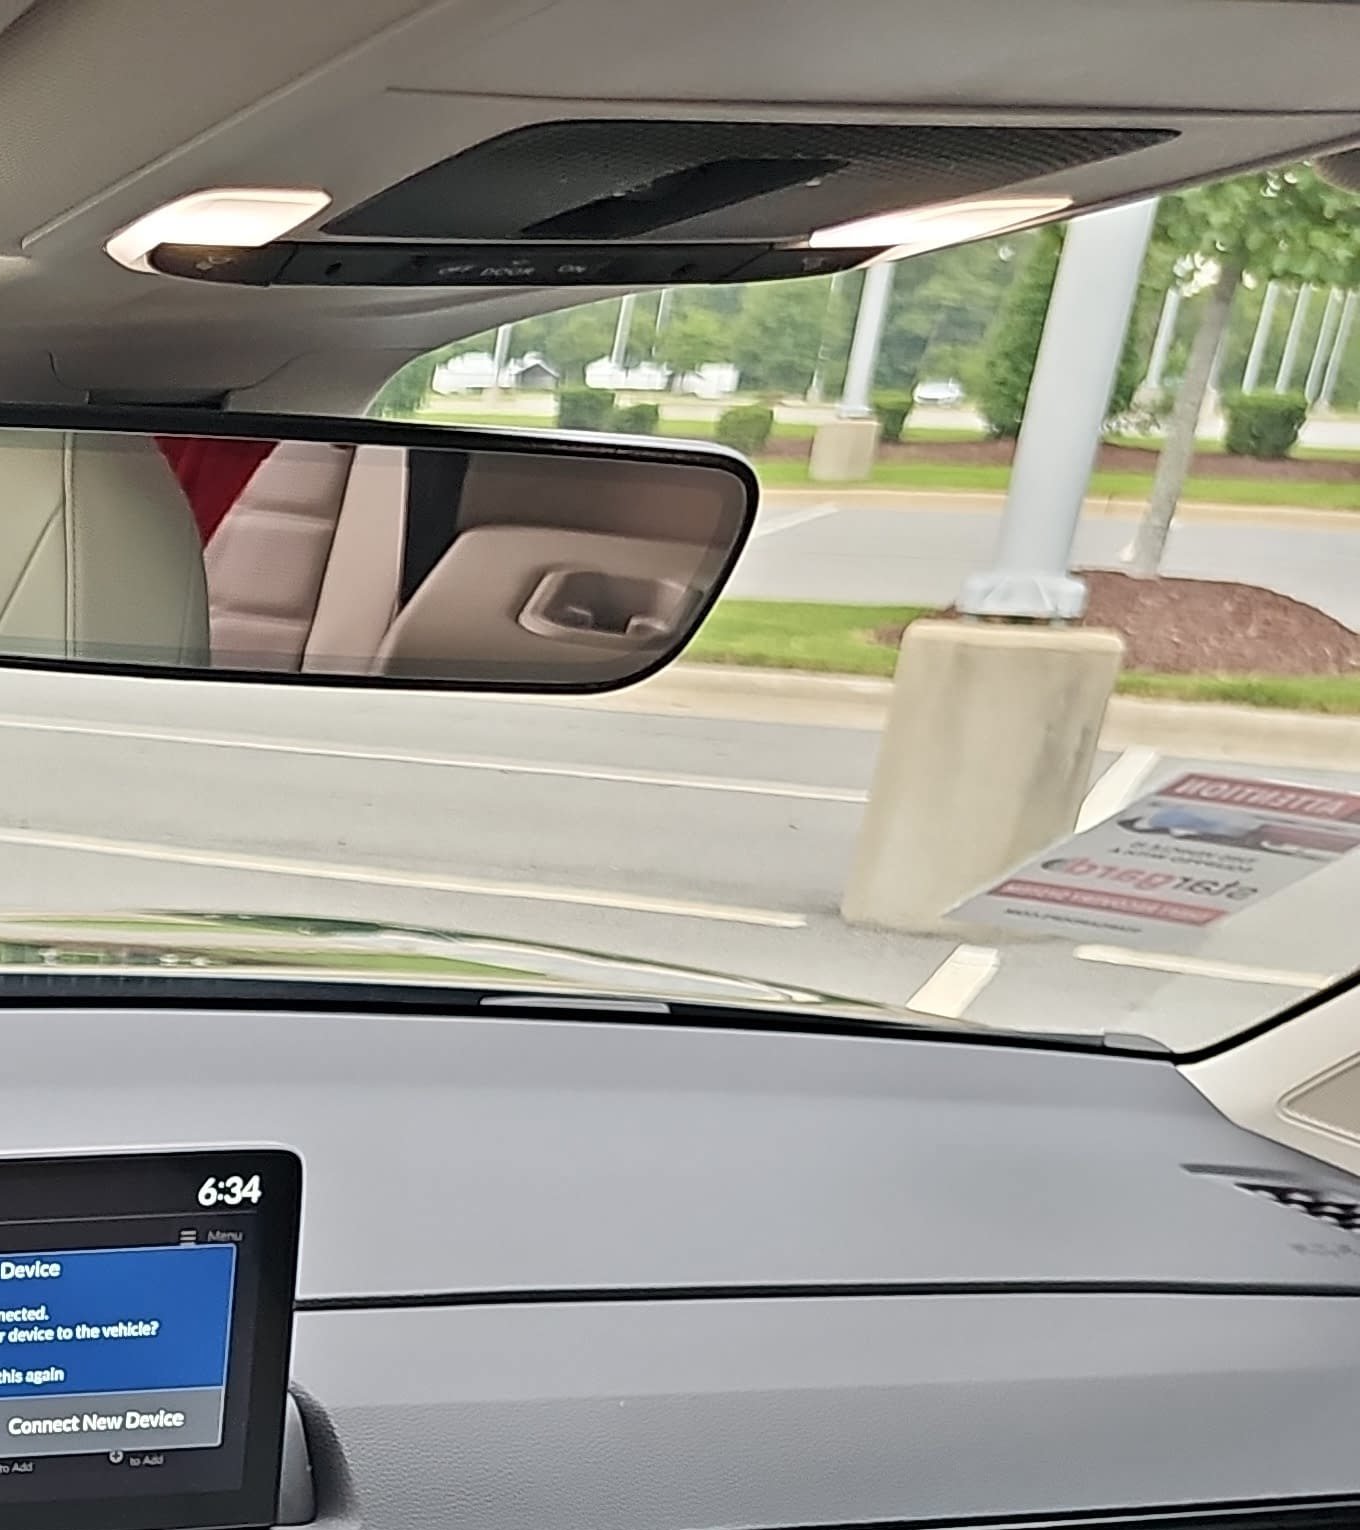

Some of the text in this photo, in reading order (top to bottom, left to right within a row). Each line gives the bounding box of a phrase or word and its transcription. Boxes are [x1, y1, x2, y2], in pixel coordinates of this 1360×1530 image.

[197, 1174, 262, 1207] 6:34
[207, 1230, 243, 1243] Menu
[0, 1261, 62, 1280] Device
[8, 1325, 55, 1343] device
[56, 1325, 73, 1341] to
[75, 1323, 100, 1340] the
[102, 1320, 160, 1338] vehicle?
[25, 1366, 65, 1386] again
[8, 1409, 185, 1436] Connect New Device
[12, 1462, 33, 1473] Add
[129, 1454, 164, 1467] to Add
